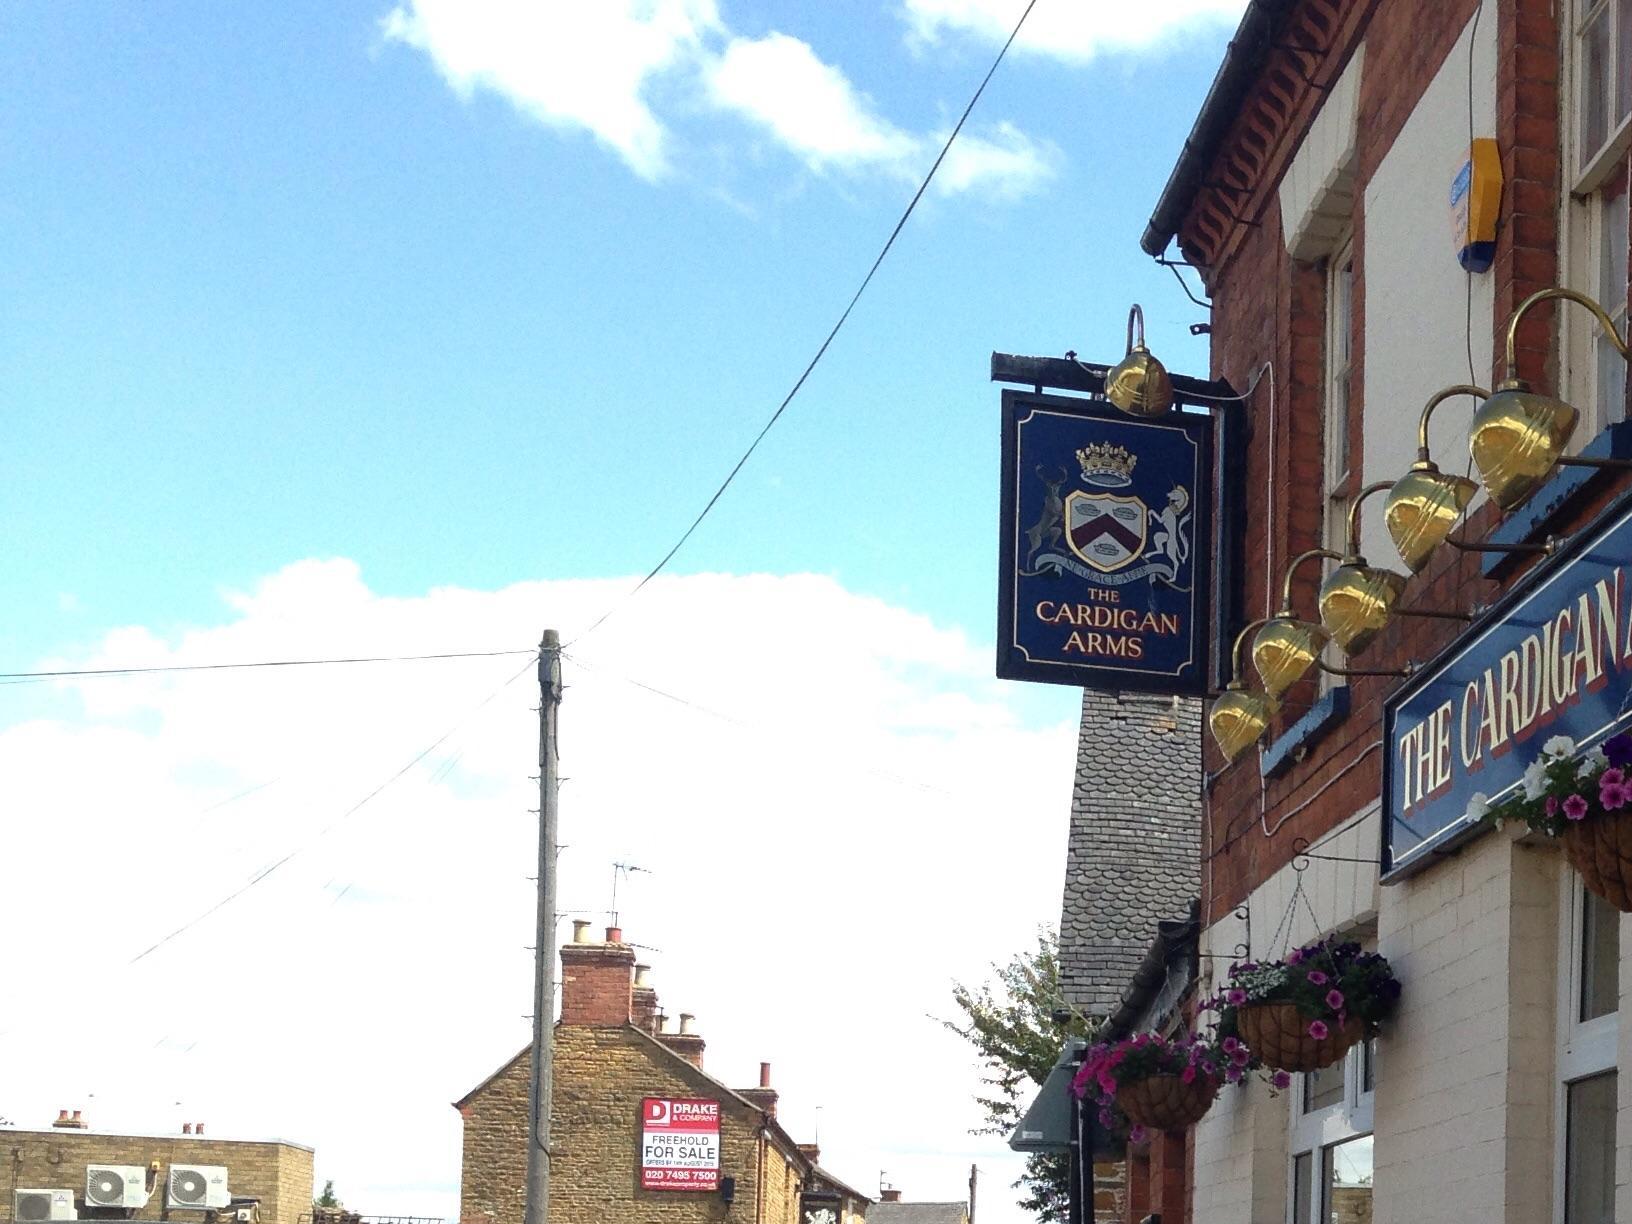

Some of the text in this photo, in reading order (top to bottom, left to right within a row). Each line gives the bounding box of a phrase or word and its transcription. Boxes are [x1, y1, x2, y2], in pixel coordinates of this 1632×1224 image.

[1088, 588, 1120, 602] THE
[1036, 601, 1178, 634] CARDIGAN
[1062, 631, 1142, 658] ARMS
[1400, 700, 1453, 813] THE
[1461, 567, 1624, 769] CARDIGAN
[673, 1103, 718, 1115] DRAKE
[652, 1135, 709, 1146] FREEHOLD
[645, 1146, 716, 1159] FOR SALE
[645, 1170, 664, 1179] 020
